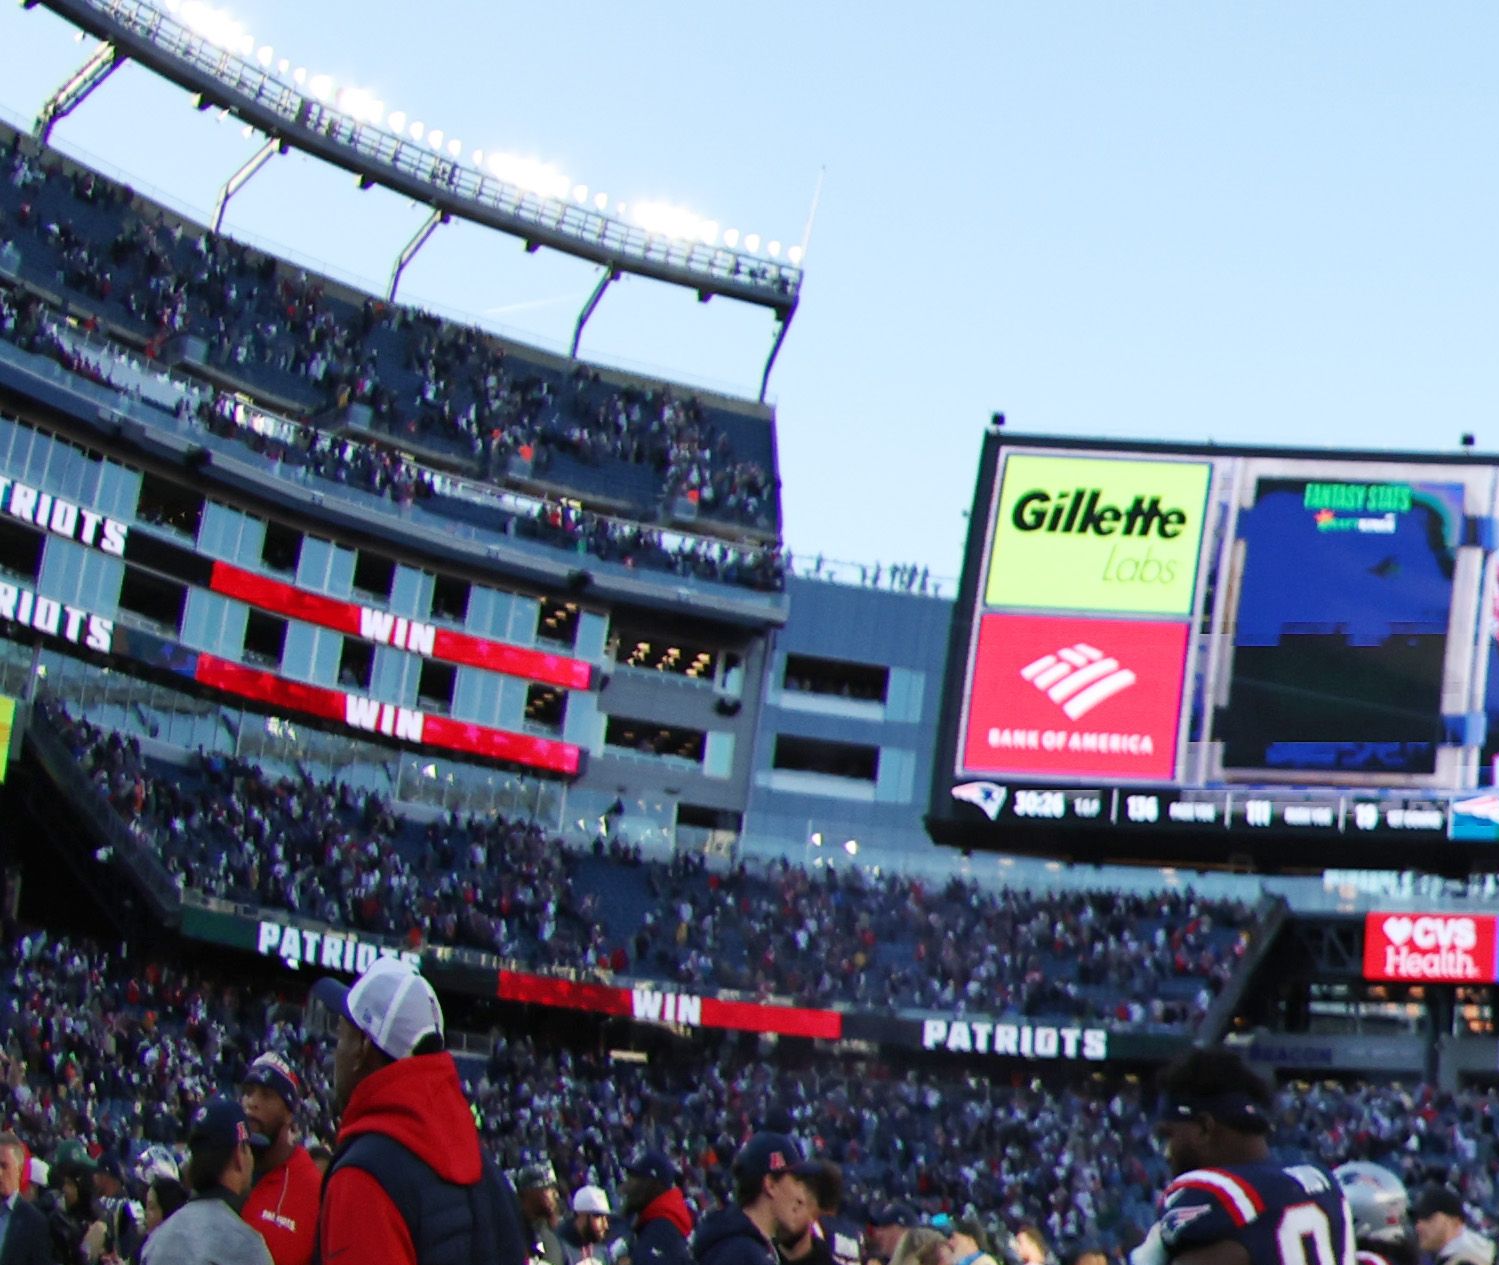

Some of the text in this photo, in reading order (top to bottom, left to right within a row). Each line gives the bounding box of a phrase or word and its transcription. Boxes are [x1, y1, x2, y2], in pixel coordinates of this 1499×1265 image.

[1012, 488, 1187, 539] Gillette
[360, 607, 436, 658] WIN
[346, 693, 424, 743] WIN
[987, 727, 1155, 756] BANK OF AMERICA
[1412, 916, 1477, 950] CVS
[632, 989, 702, 1026] WIN
[922, 1018, 1108, 1061] PATRIOTS
